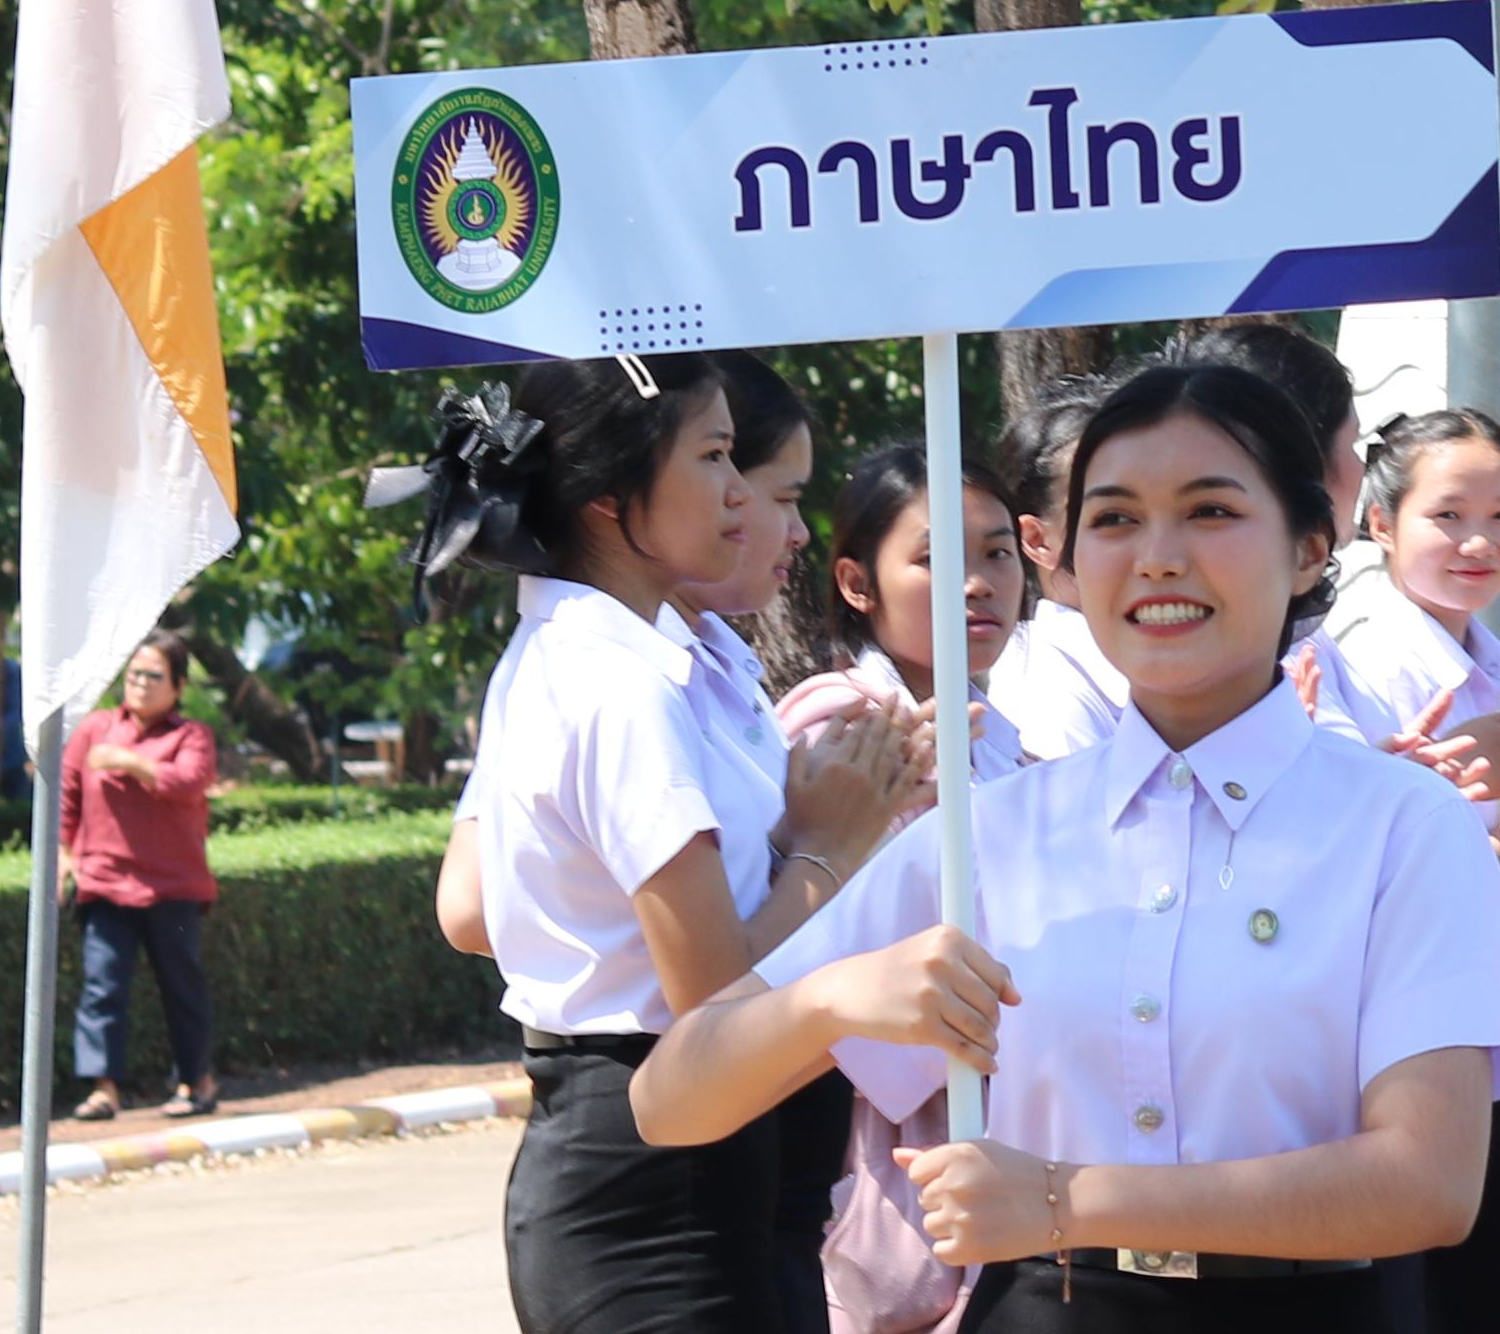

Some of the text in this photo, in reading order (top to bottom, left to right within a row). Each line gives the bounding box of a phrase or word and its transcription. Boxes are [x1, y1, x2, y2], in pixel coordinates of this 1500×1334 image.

[734, 88, 1243, 232] ภาษาไทย
[396, 196, 557, 312] KAMPHAENG PHET RAJABHAT UNIVERSITY
